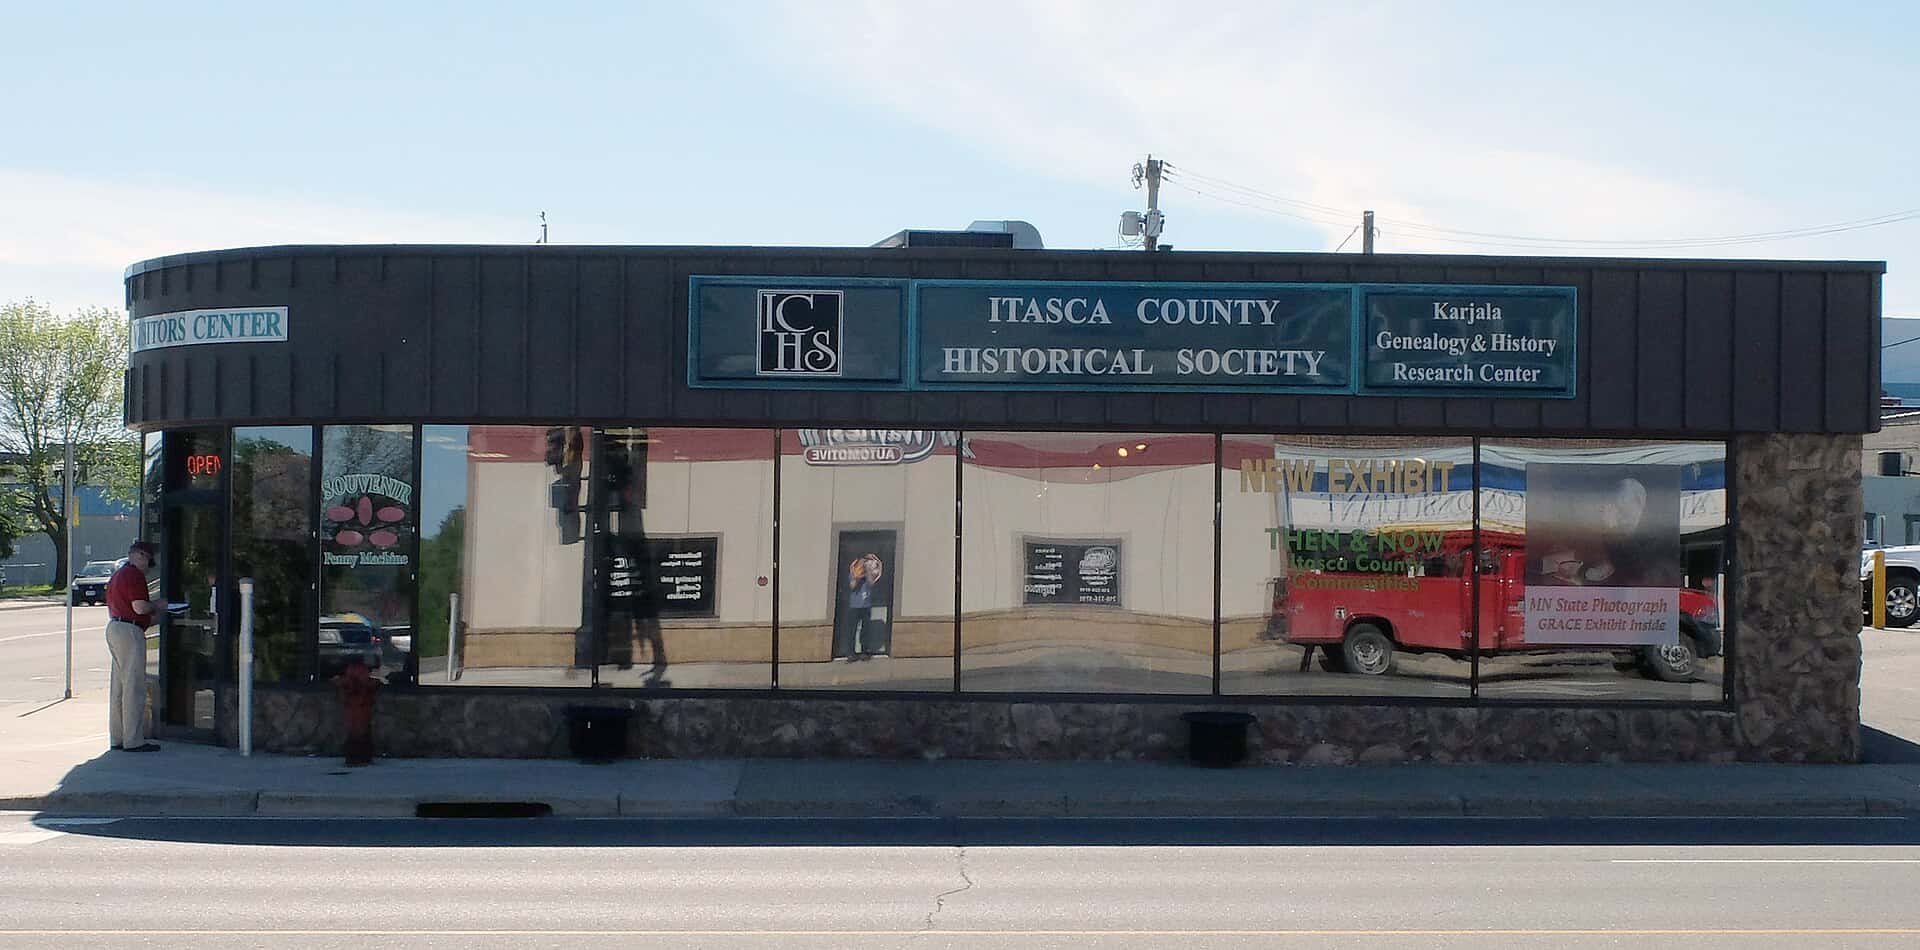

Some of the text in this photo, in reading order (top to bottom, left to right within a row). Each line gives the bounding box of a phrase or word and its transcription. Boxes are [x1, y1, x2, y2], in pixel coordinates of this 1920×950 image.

[988, 296, 1280, 326] ITASCA COUNTY
[1433, 302, 1502, 325] Karjala
[134, 311, 283, 347] ISITORS CENTER
[1376, 331, 1557, 357] Genealogy & History
[941, 347, 1326, 377] HISTORICAL SOCIETY
[1392, 362, 1541, 382] Research Center
[187, 455, 221, 475] OPEN
[1239, 458, 1455, 494] NEW EXHIBIT
[322, 473, 412, 505] SOUVENIR
[1264, 527, 1446, 554] THEN & NOW
[324, 551, 409, 569] Penny Machine
[1291, 553, 1425, 576] Itasca County
[1292, 573, 1420, 593] Communities
[1529, 597, 1668, 616] MN State Photograph
[1537, 618, 1667, 632] GRACE Exhibit Inside
